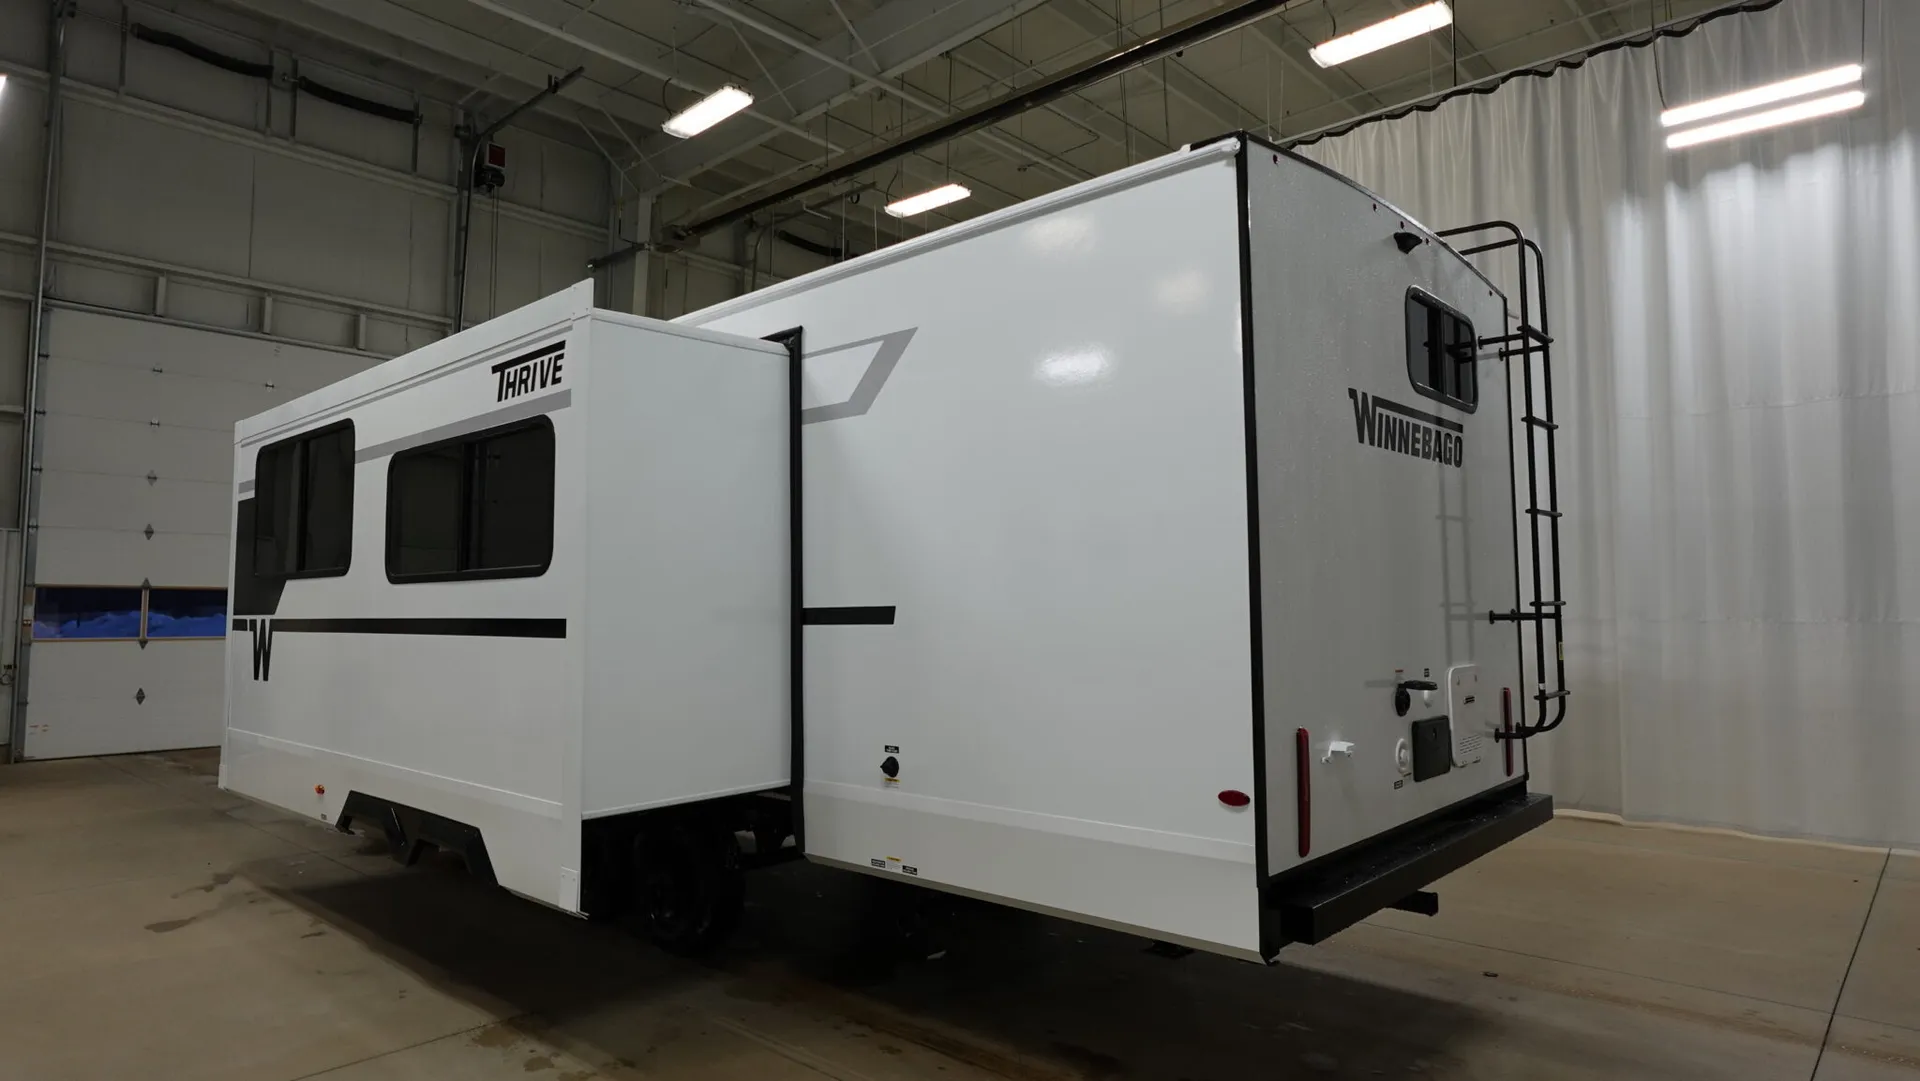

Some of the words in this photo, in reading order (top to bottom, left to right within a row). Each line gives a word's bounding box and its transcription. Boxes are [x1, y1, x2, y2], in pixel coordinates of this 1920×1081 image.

[491, 339, 566, 403] THRIVE
[1348, 387, 1464, 468] WINNEBAGO
[249, 618, 274, 682] W
